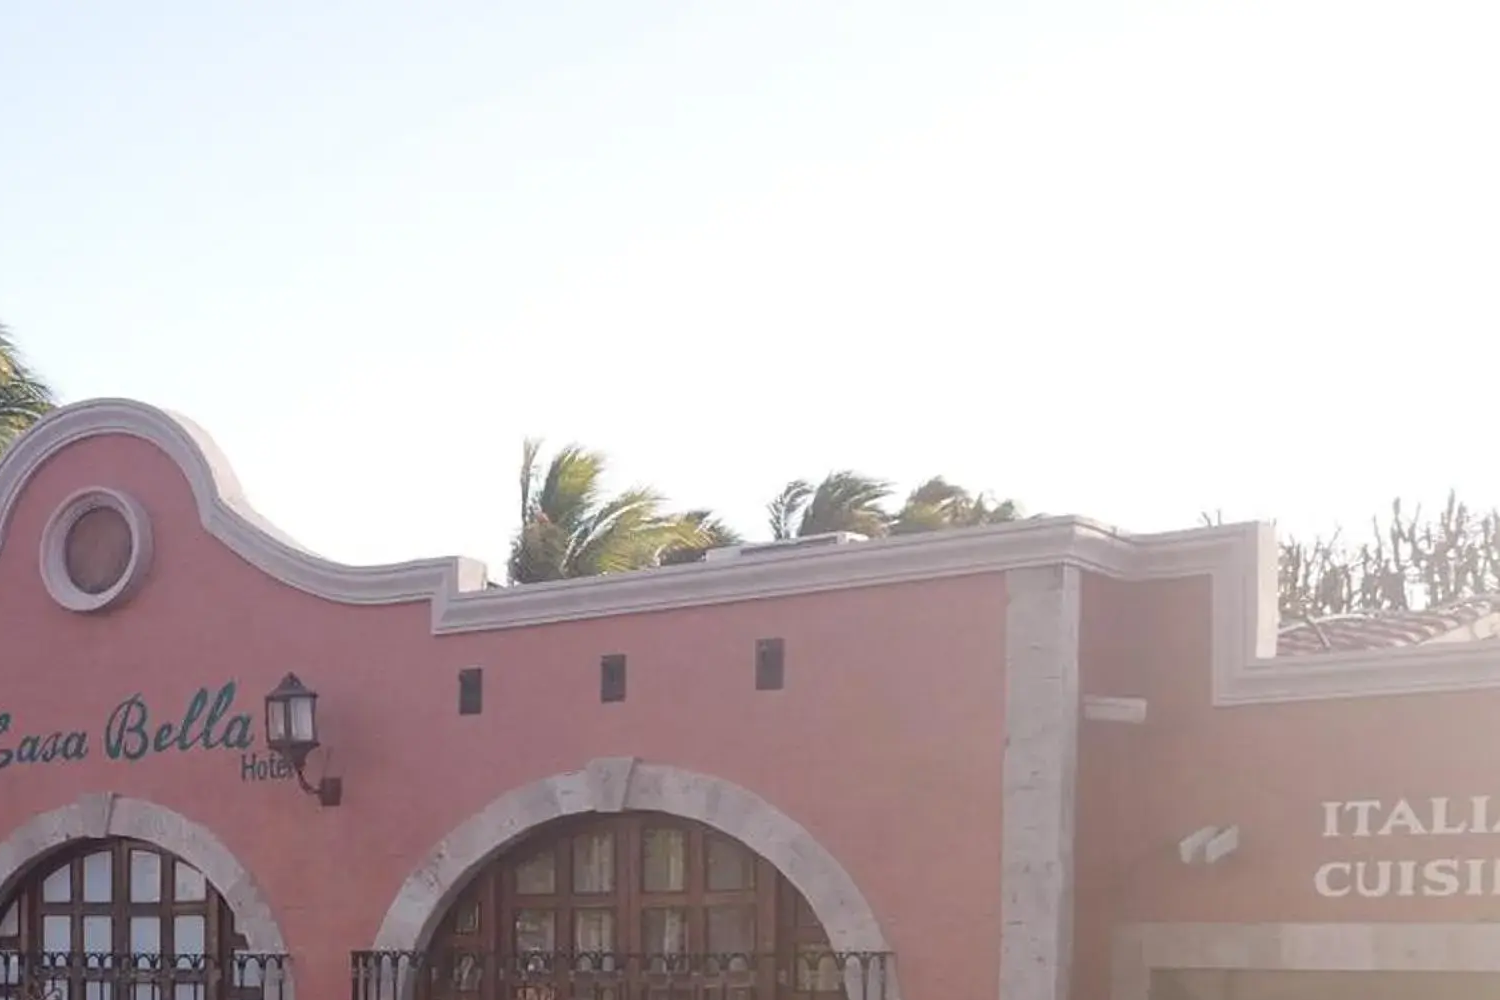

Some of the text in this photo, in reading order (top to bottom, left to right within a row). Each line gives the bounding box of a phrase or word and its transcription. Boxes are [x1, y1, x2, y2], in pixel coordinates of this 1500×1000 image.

[105, 679, 254, 761] Bella
[1320, 794, 1500, 837] ITALI
[1313, 857, 1500, 898] CUISI
